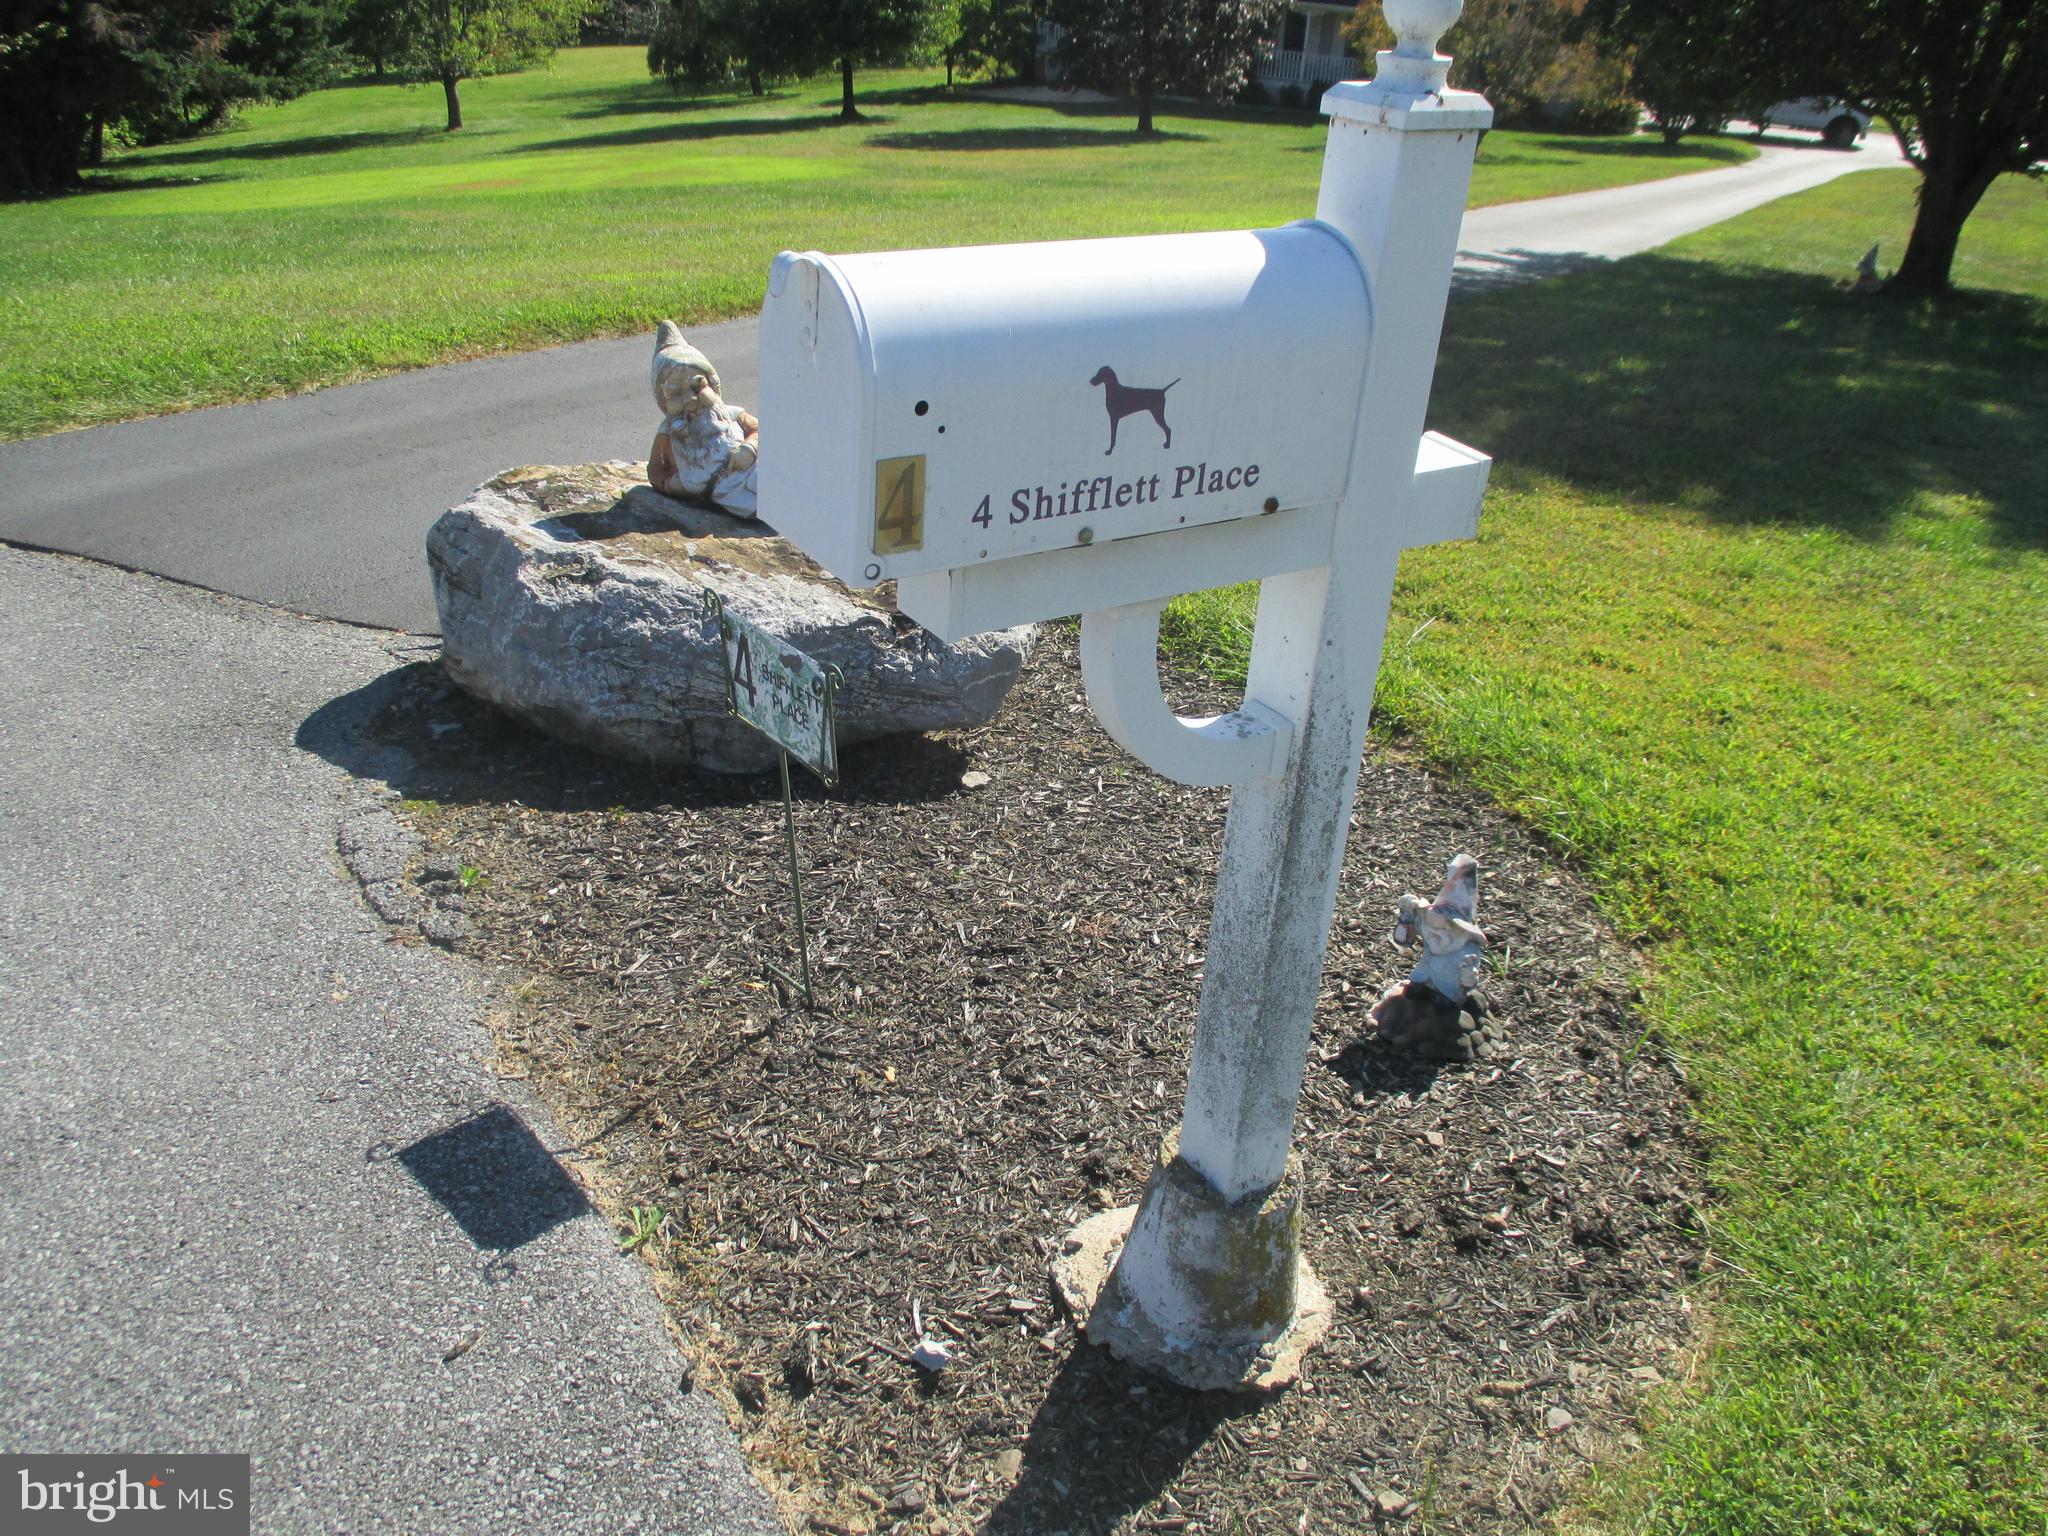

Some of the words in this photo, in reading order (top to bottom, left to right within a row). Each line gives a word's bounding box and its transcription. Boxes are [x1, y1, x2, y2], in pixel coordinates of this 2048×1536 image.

[877, 459, 922, 549] 4
[971, 494, 994, 530] 4
[1008, 472, 1161, 525] Shifflett
[1170, 462, 1261, 499] Place
[733, 632, 758, 708] 4
[772, 692, 810, 732] PLACE
